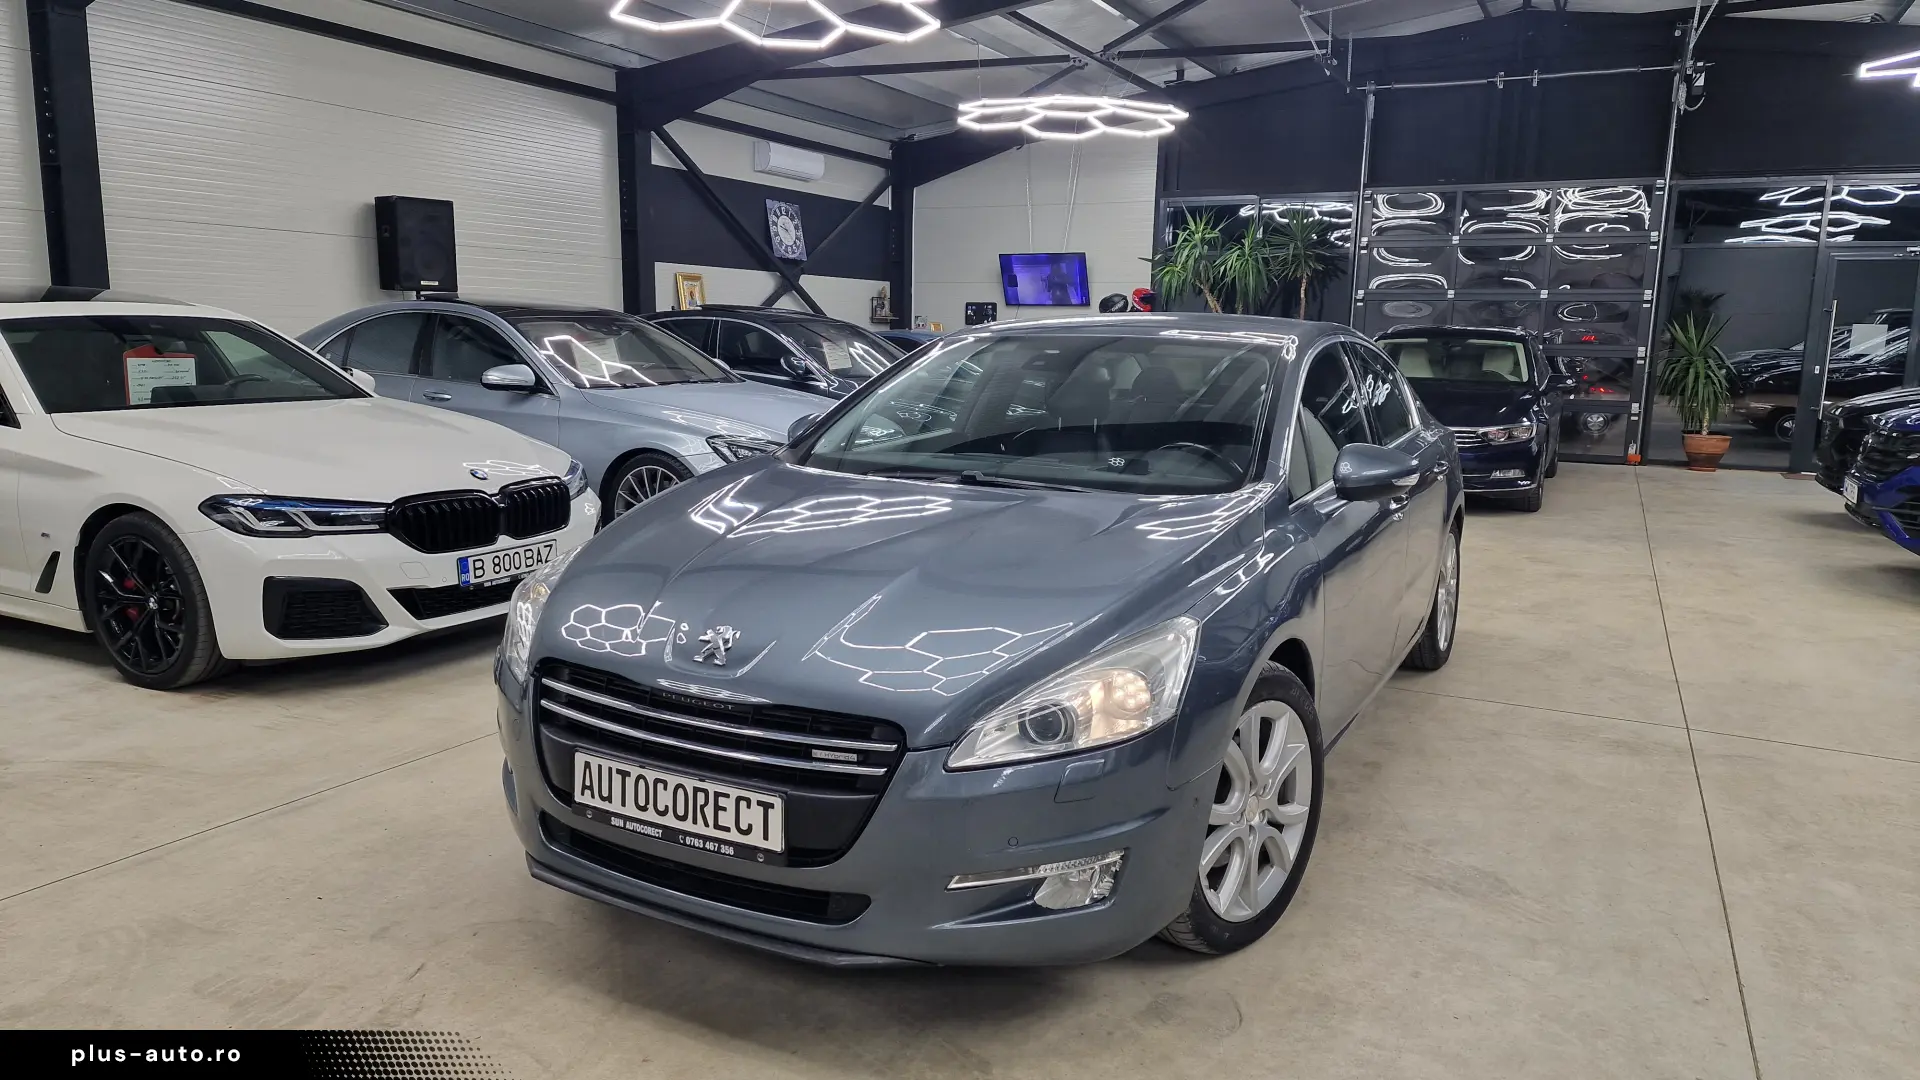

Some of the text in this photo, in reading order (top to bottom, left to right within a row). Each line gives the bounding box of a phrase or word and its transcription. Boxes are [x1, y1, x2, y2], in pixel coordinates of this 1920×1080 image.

[461, 573, 470, 582] RO
[472, 543, 554, 579] B 800 BAZ
[580, 760, 775, 842] AUTOCORECT
[611, 816, 735, 856] SUN AUTOCORECT 0763 467 356
